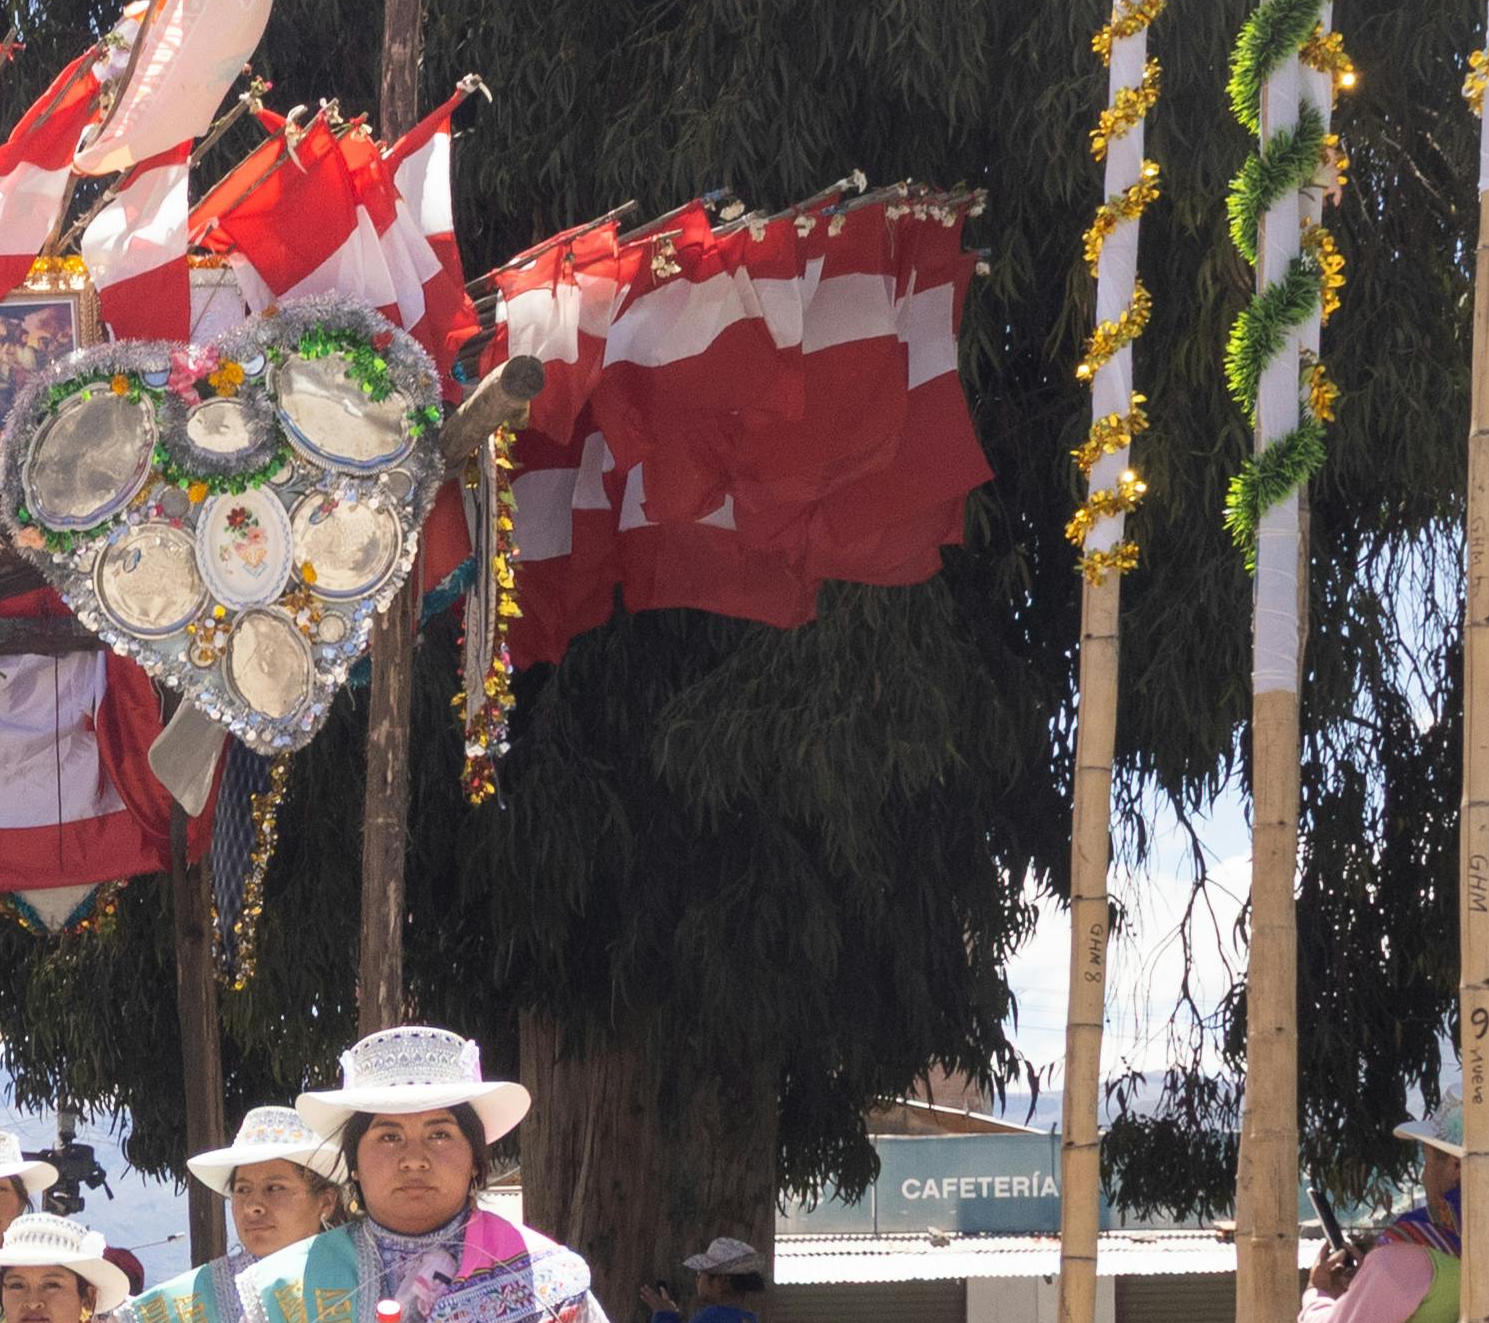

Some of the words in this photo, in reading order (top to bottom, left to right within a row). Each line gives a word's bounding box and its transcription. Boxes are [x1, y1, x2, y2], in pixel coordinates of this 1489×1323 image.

[1469, 853, 1489, 913] GHM
[1084, 970, 1103, 983] 8
[901, 1171, 1059, 1200] CAFETERÍA
